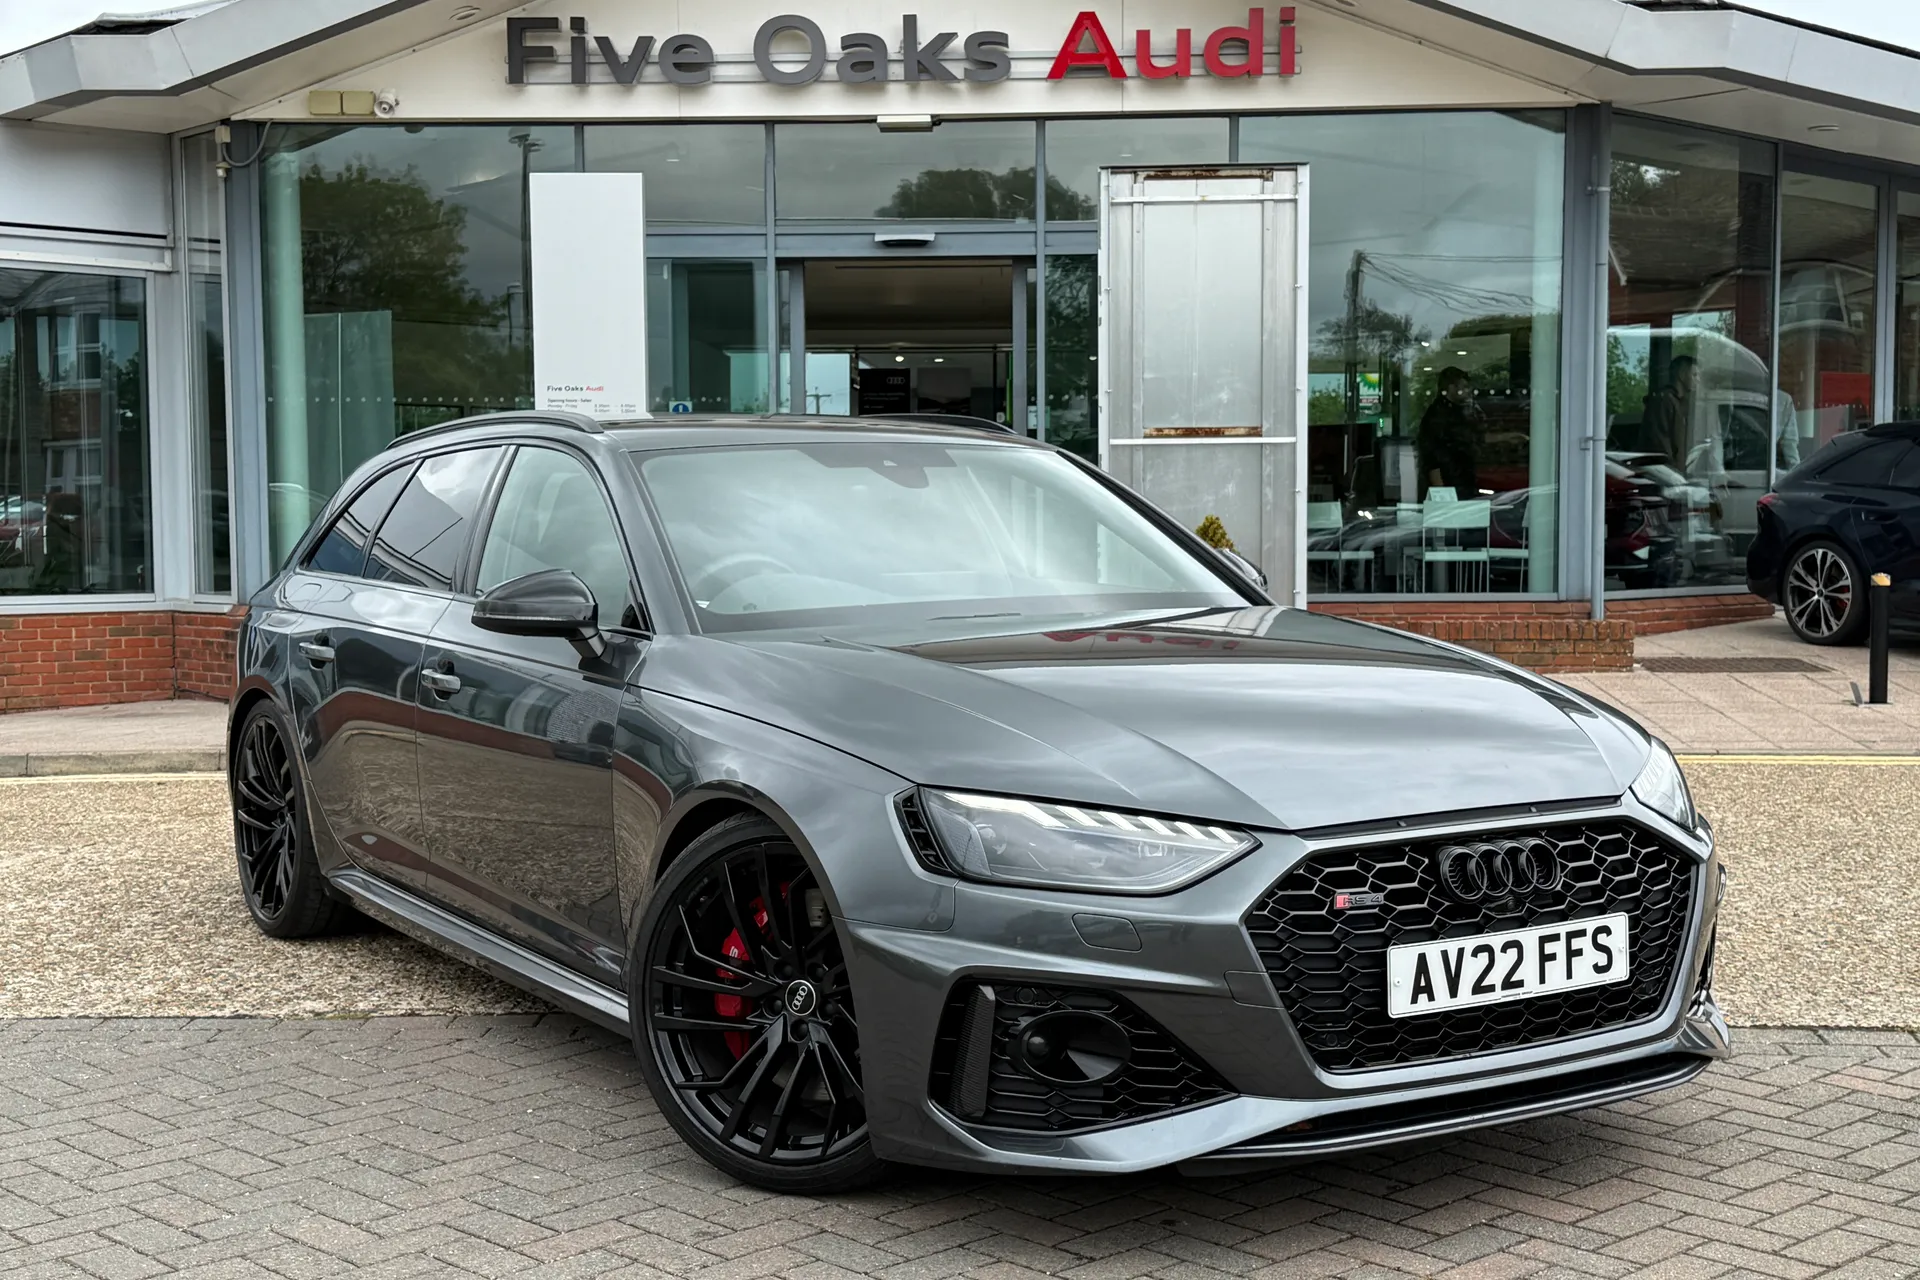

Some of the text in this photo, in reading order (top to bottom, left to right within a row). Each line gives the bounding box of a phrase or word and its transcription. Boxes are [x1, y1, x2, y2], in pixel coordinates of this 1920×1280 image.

[507, 7, 1296, 84] Five Oaks Audi
[1410, 925, 1613, 1005] AV22 FFS
